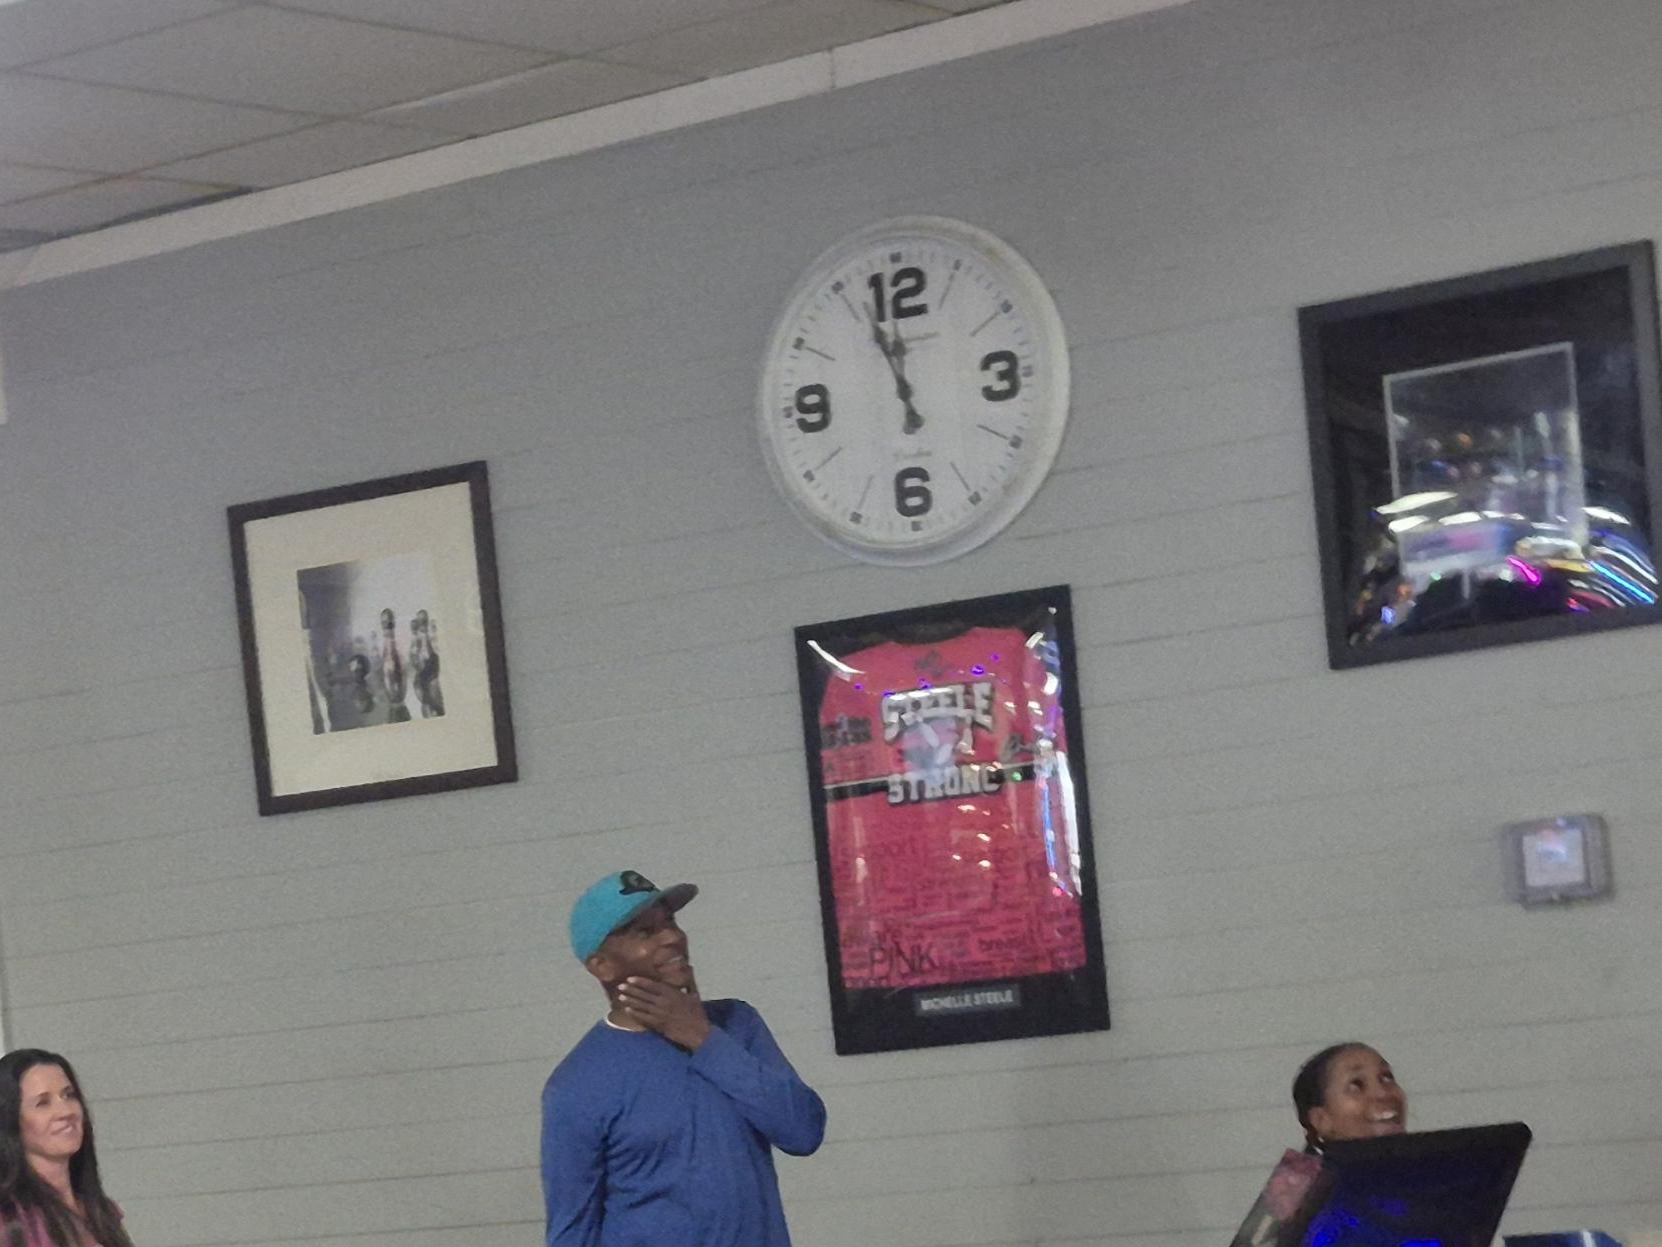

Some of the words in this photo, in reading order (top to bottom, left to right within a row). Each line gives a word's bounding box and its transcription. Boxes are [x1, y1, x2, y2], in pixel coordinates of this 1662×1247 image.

[868, 267, 928, 322] 12
[980, 350, 1021, 402] 3
[794, 383, 832, 433] 9
[893, 466, 933, 517] 6
